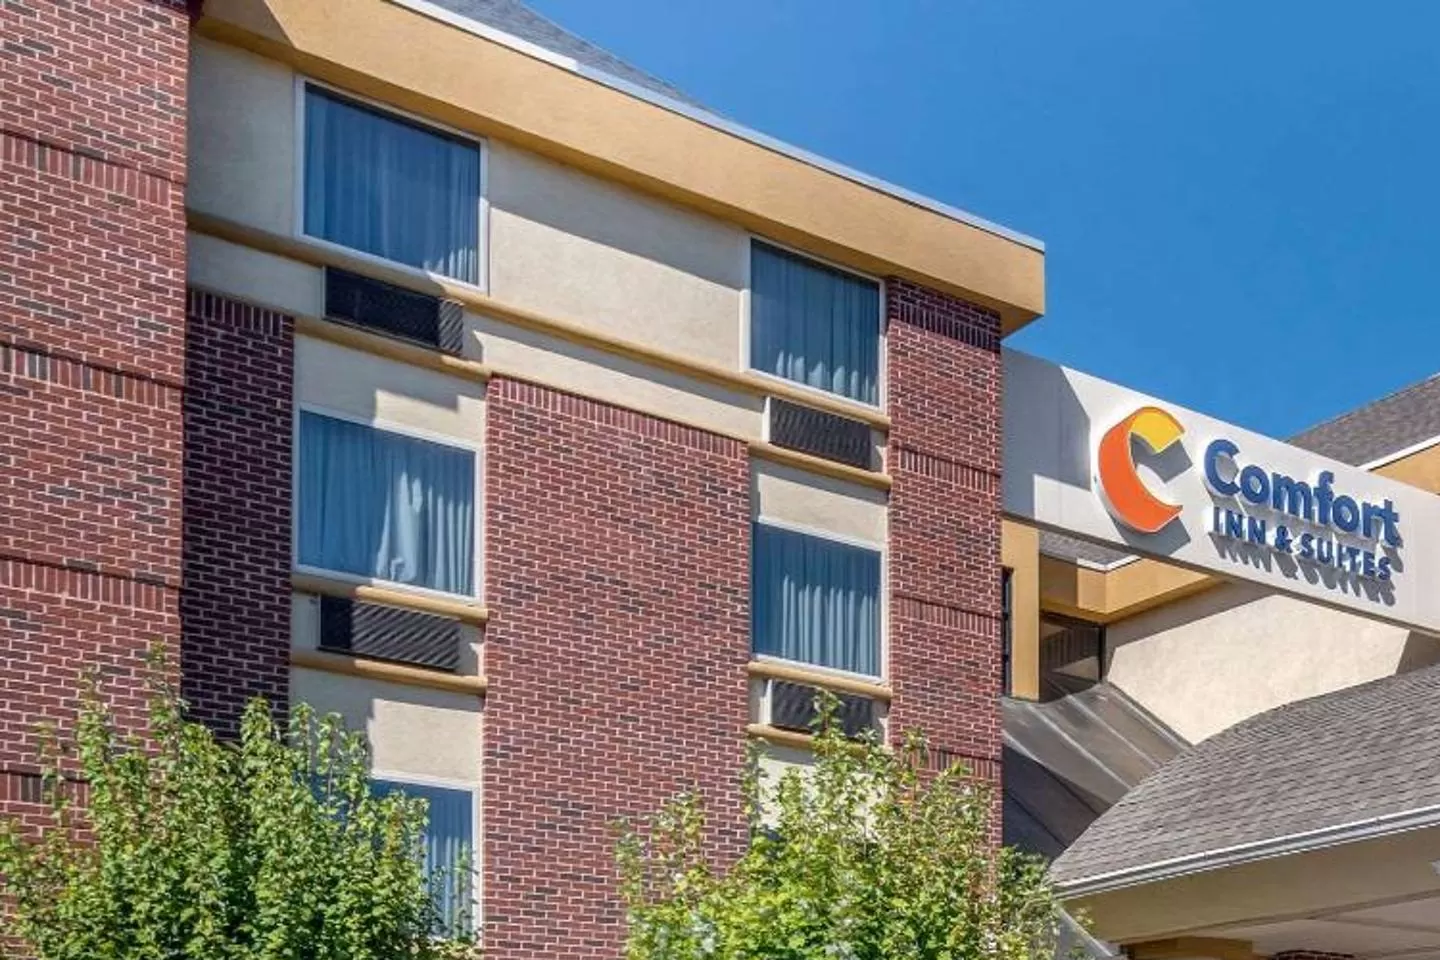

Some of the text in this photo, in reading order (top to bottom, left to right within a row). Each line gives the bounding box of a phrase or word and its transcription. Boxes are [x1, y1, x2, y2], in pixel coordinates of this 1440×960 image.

[1204, 439, 1403, 547] Comfort
[1213, 506, 1392, 581] INN & SUITES
